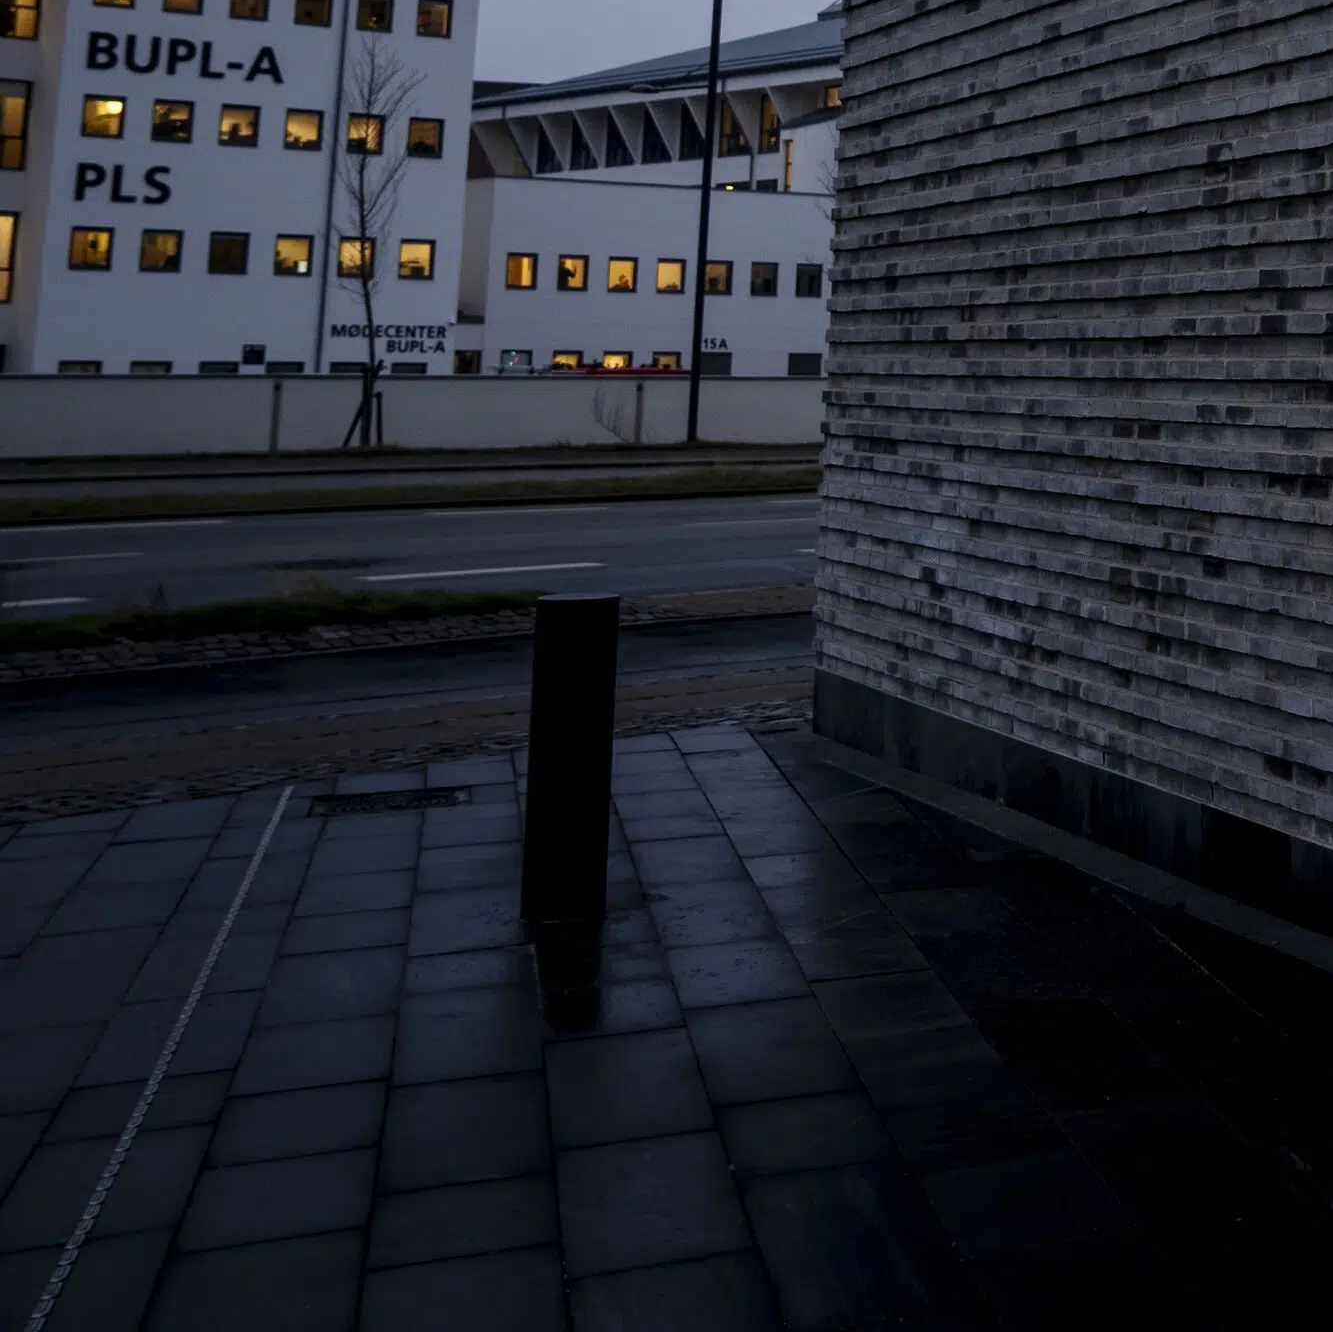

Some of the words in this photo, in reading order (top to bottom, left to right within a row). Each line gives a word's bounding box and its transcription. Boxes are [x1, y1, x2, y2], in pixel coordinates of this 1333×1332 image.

[86, 31, 284, 85] BUPL-A
[73, 162, 172, 205] PLS
[386, 339, 446, 353] BUPL-A
